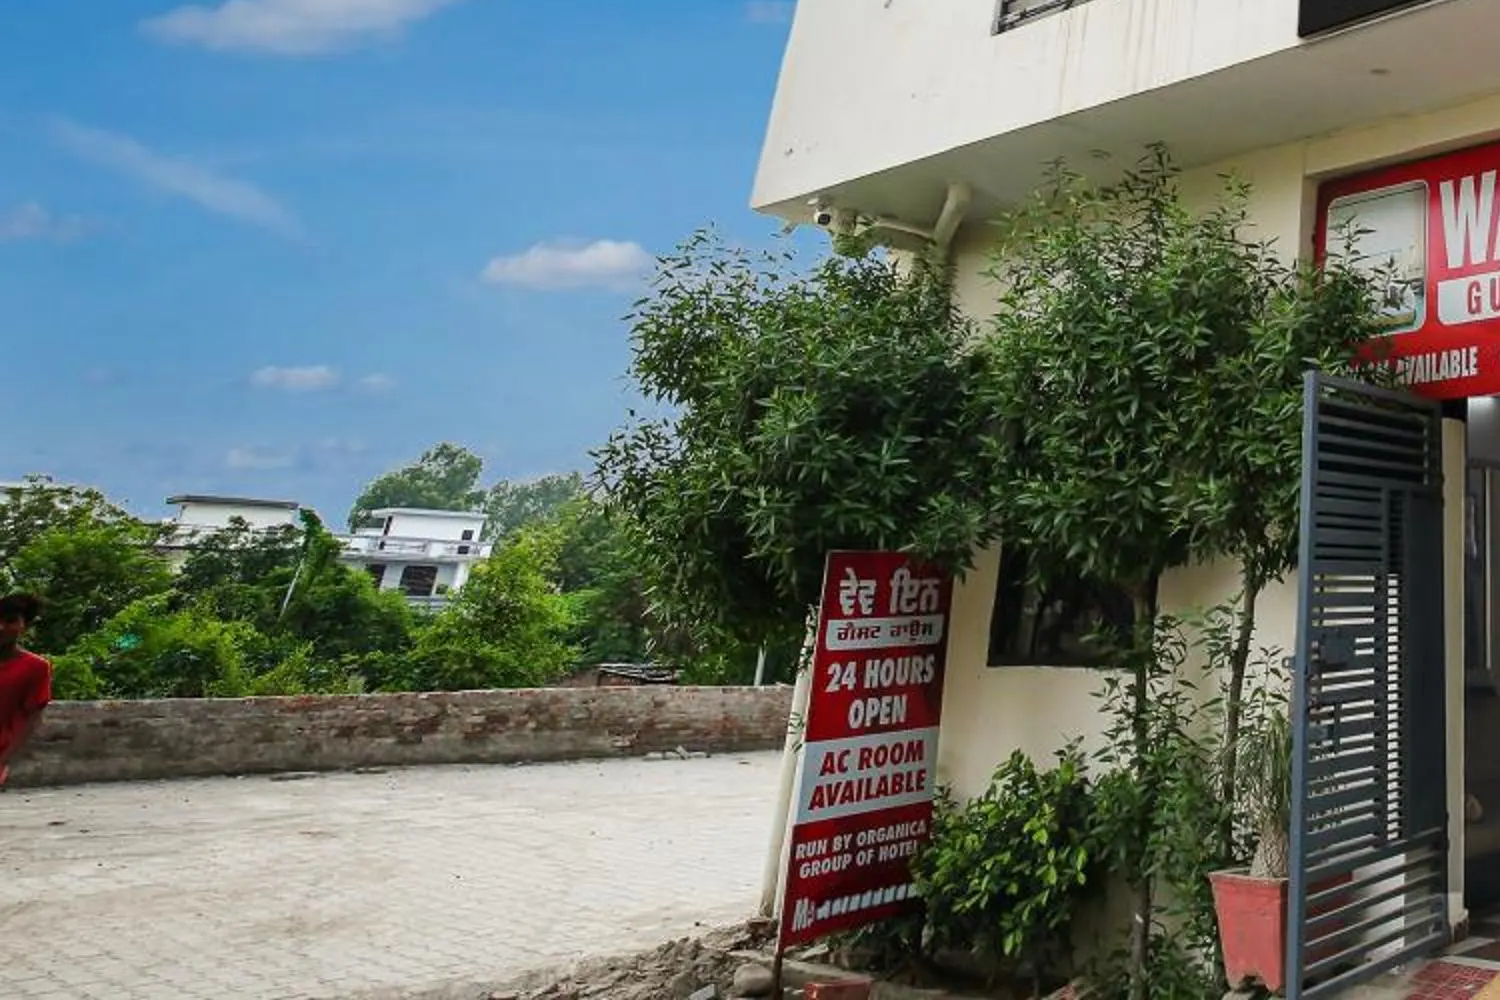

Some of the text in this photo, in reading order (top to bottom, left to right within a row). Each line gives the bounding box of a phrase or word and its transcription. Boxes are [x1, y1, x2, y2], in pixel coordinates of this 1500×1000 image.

[1395, 345, 1479, 387] AVAILABLE
[825, 654, 935, 693] 24 HOURS
[848, 694, 908, 729] OPEN
[819, 739, 926, 777] AC ROOM
[808, 769, 927, 811] AVAILABLE
[795, 819, 927, 861] RUN BY ORGANICA
[799, 855, 852, 879] GROUP
[855, 849, 876, 867] OF
